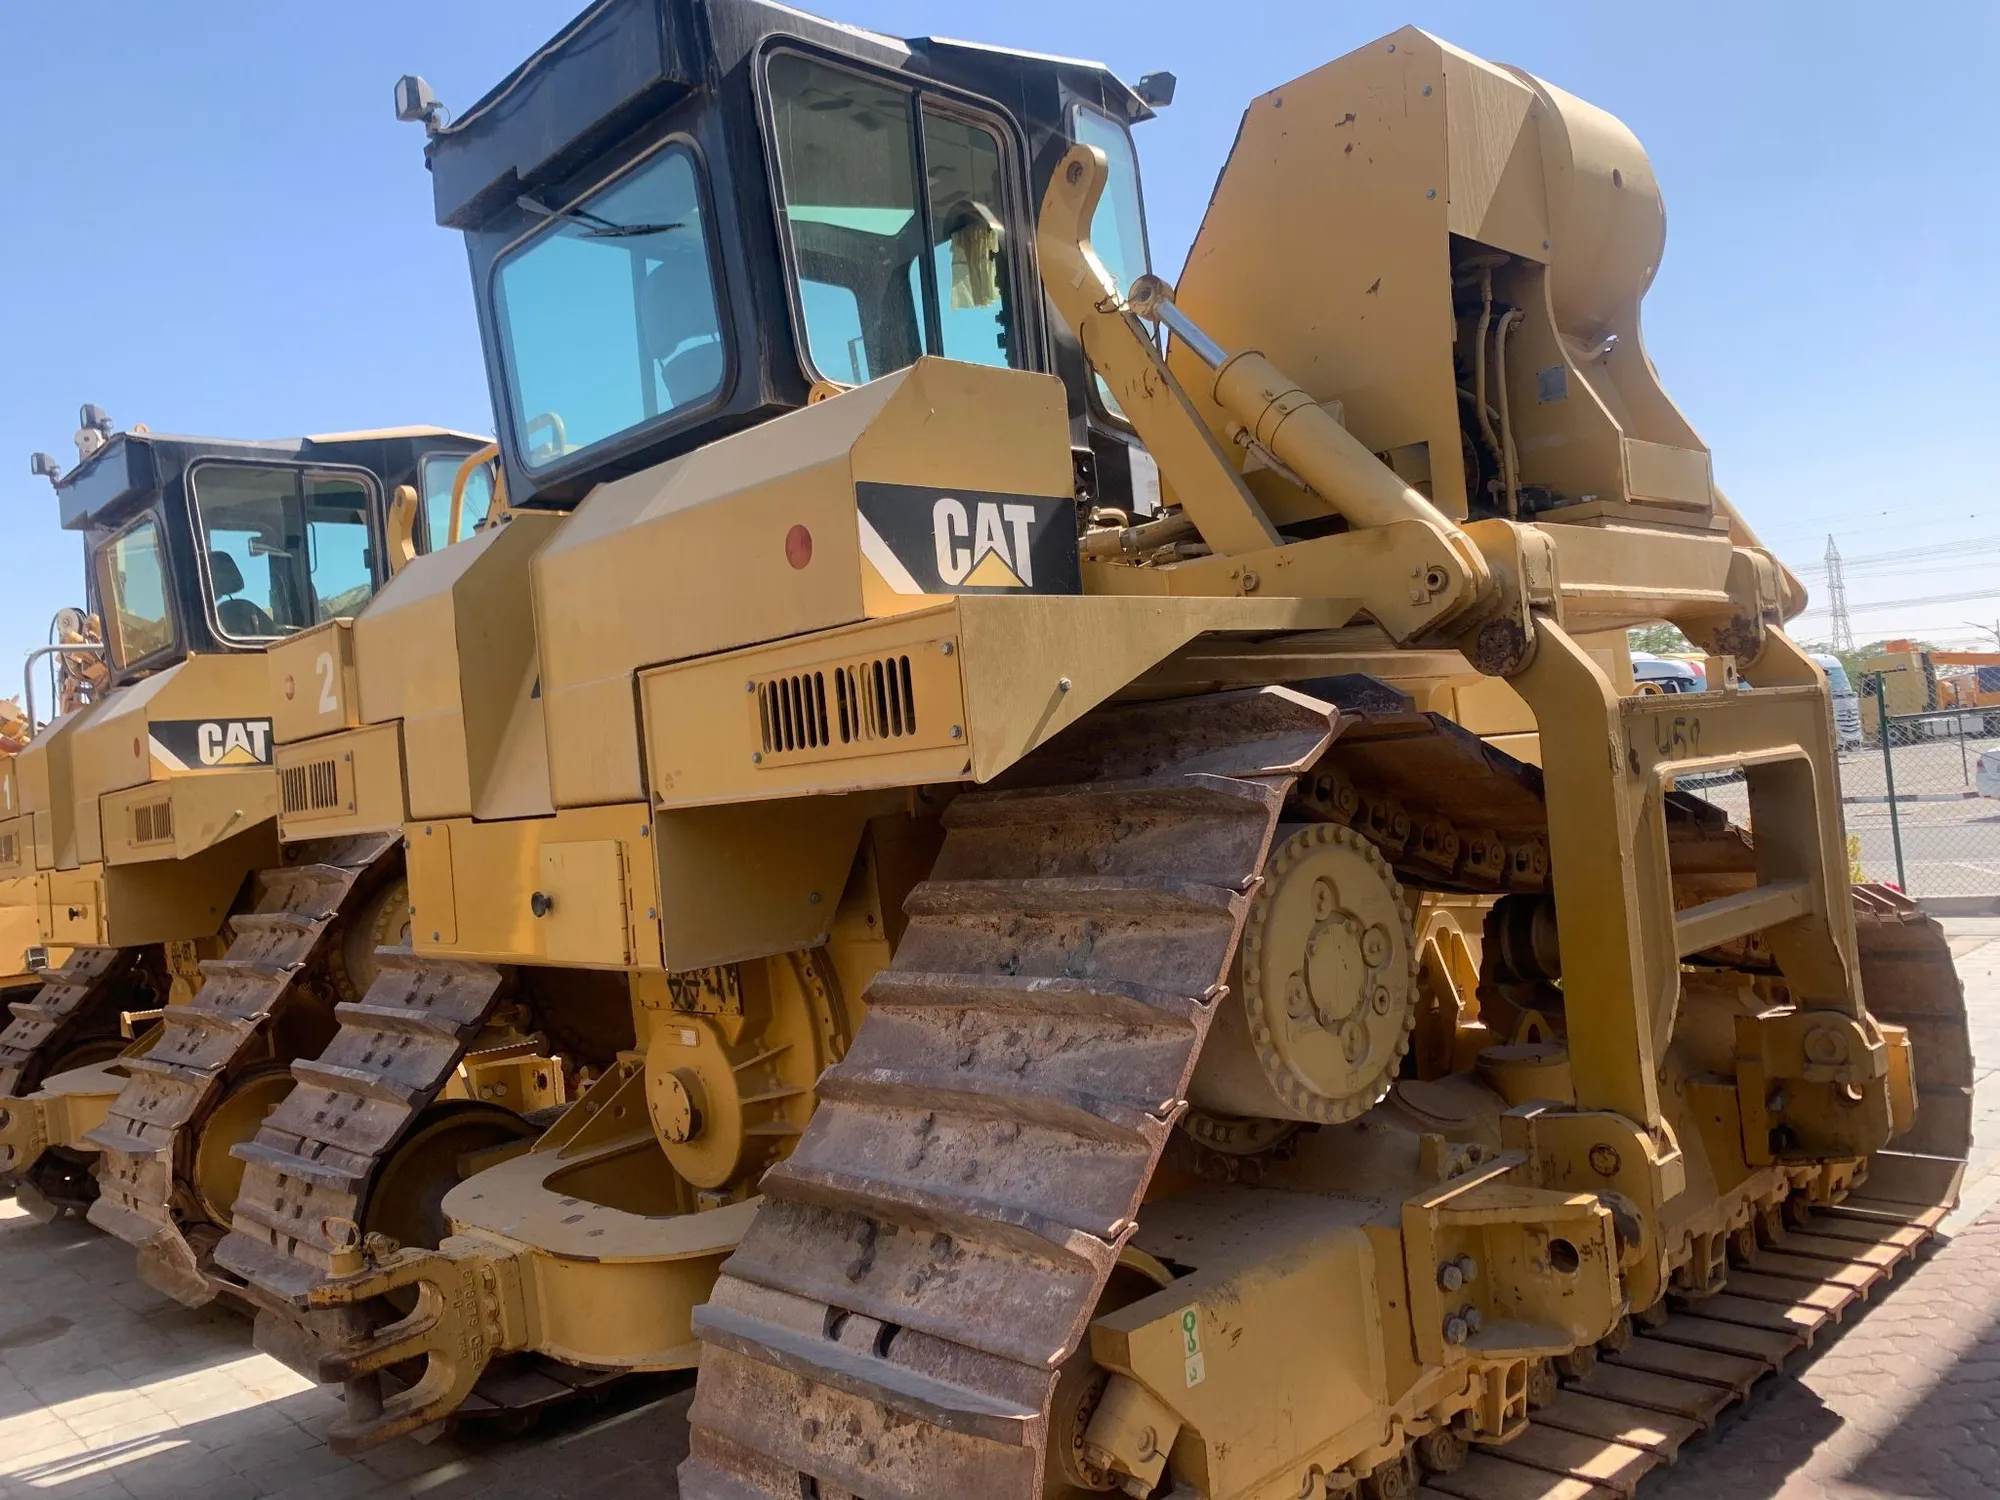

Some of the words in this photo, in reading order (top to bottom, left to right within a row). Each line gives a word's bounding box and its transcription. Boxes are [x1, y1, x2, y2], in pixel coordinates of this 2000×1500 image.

[933, 498, 1036, 587] CAT
[316, 651, 337, 714] 2
[198, 721, 270, 765] CAT
